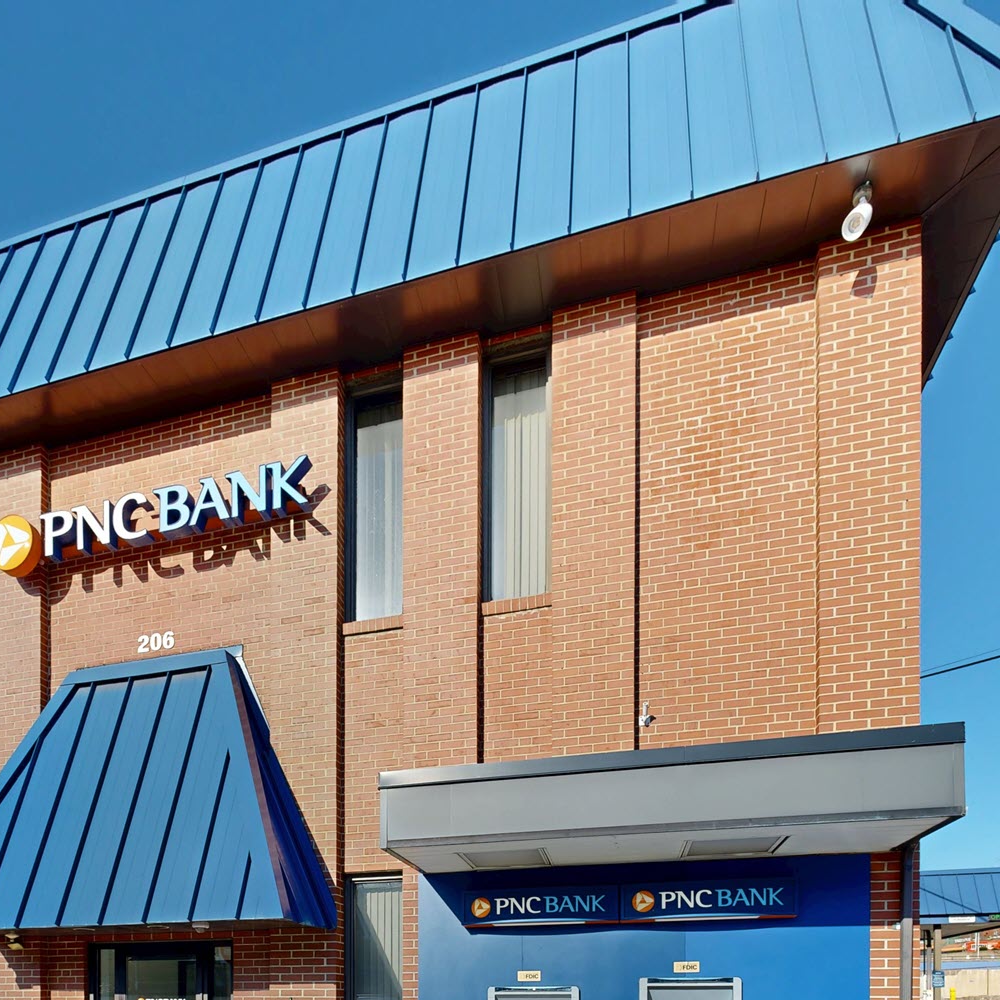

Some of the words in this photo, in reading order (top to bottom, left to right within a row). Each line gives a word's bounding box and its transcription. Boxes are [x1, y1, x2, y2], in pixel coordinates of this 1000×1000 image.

[39, 492, 149, 558] PNC
[152, 453, 309, 534] BANK
[137, 631, 176, 653] 206
[494, 896, 541, 915] PNC
[543, 894, 606, 913] BANK
[658, 889, 713, 909] PNC
[715, 887, 784, 907] BANK
